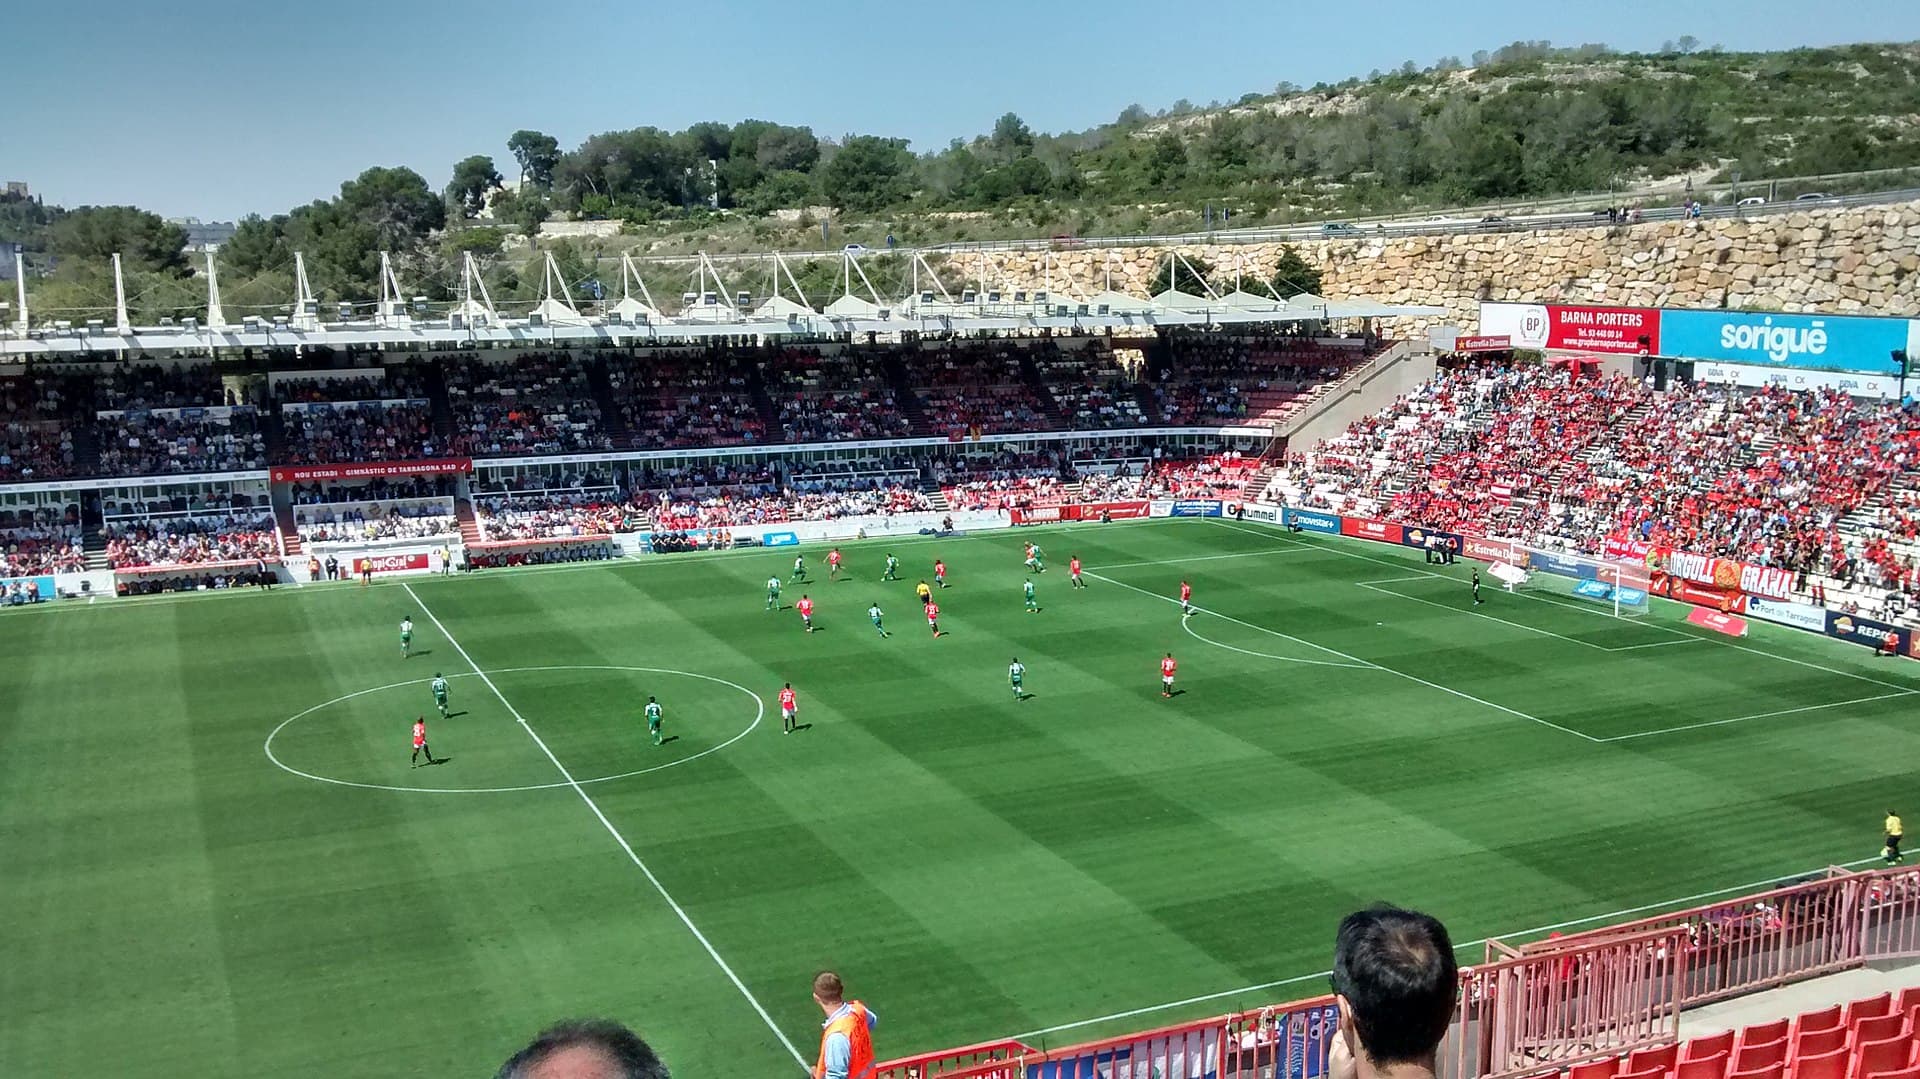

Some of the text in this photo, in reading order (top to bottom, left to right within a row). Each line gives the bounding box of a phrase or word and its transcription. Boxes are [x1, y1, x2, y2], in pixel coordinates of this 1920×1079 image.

[1526, 317, 1540, 332] BP
[1561, 311, 1643, 327] BARNA PORTERS
[294, 471, 310, 479] NOU
[312, 470, 338, 479] ESTADI
[387, 466, 398, 474] DE
[399, 464, 440, 474] TARRAGONA
[442, 463, 456, 471] SAD
[1474, 543, 1522, 561] Estrella Dmm
[1670, 551, 1715, 585] ORGULL
[1760, 602, 1775, 616] Port
[1785, 608, 1823, 626] Tarragona
